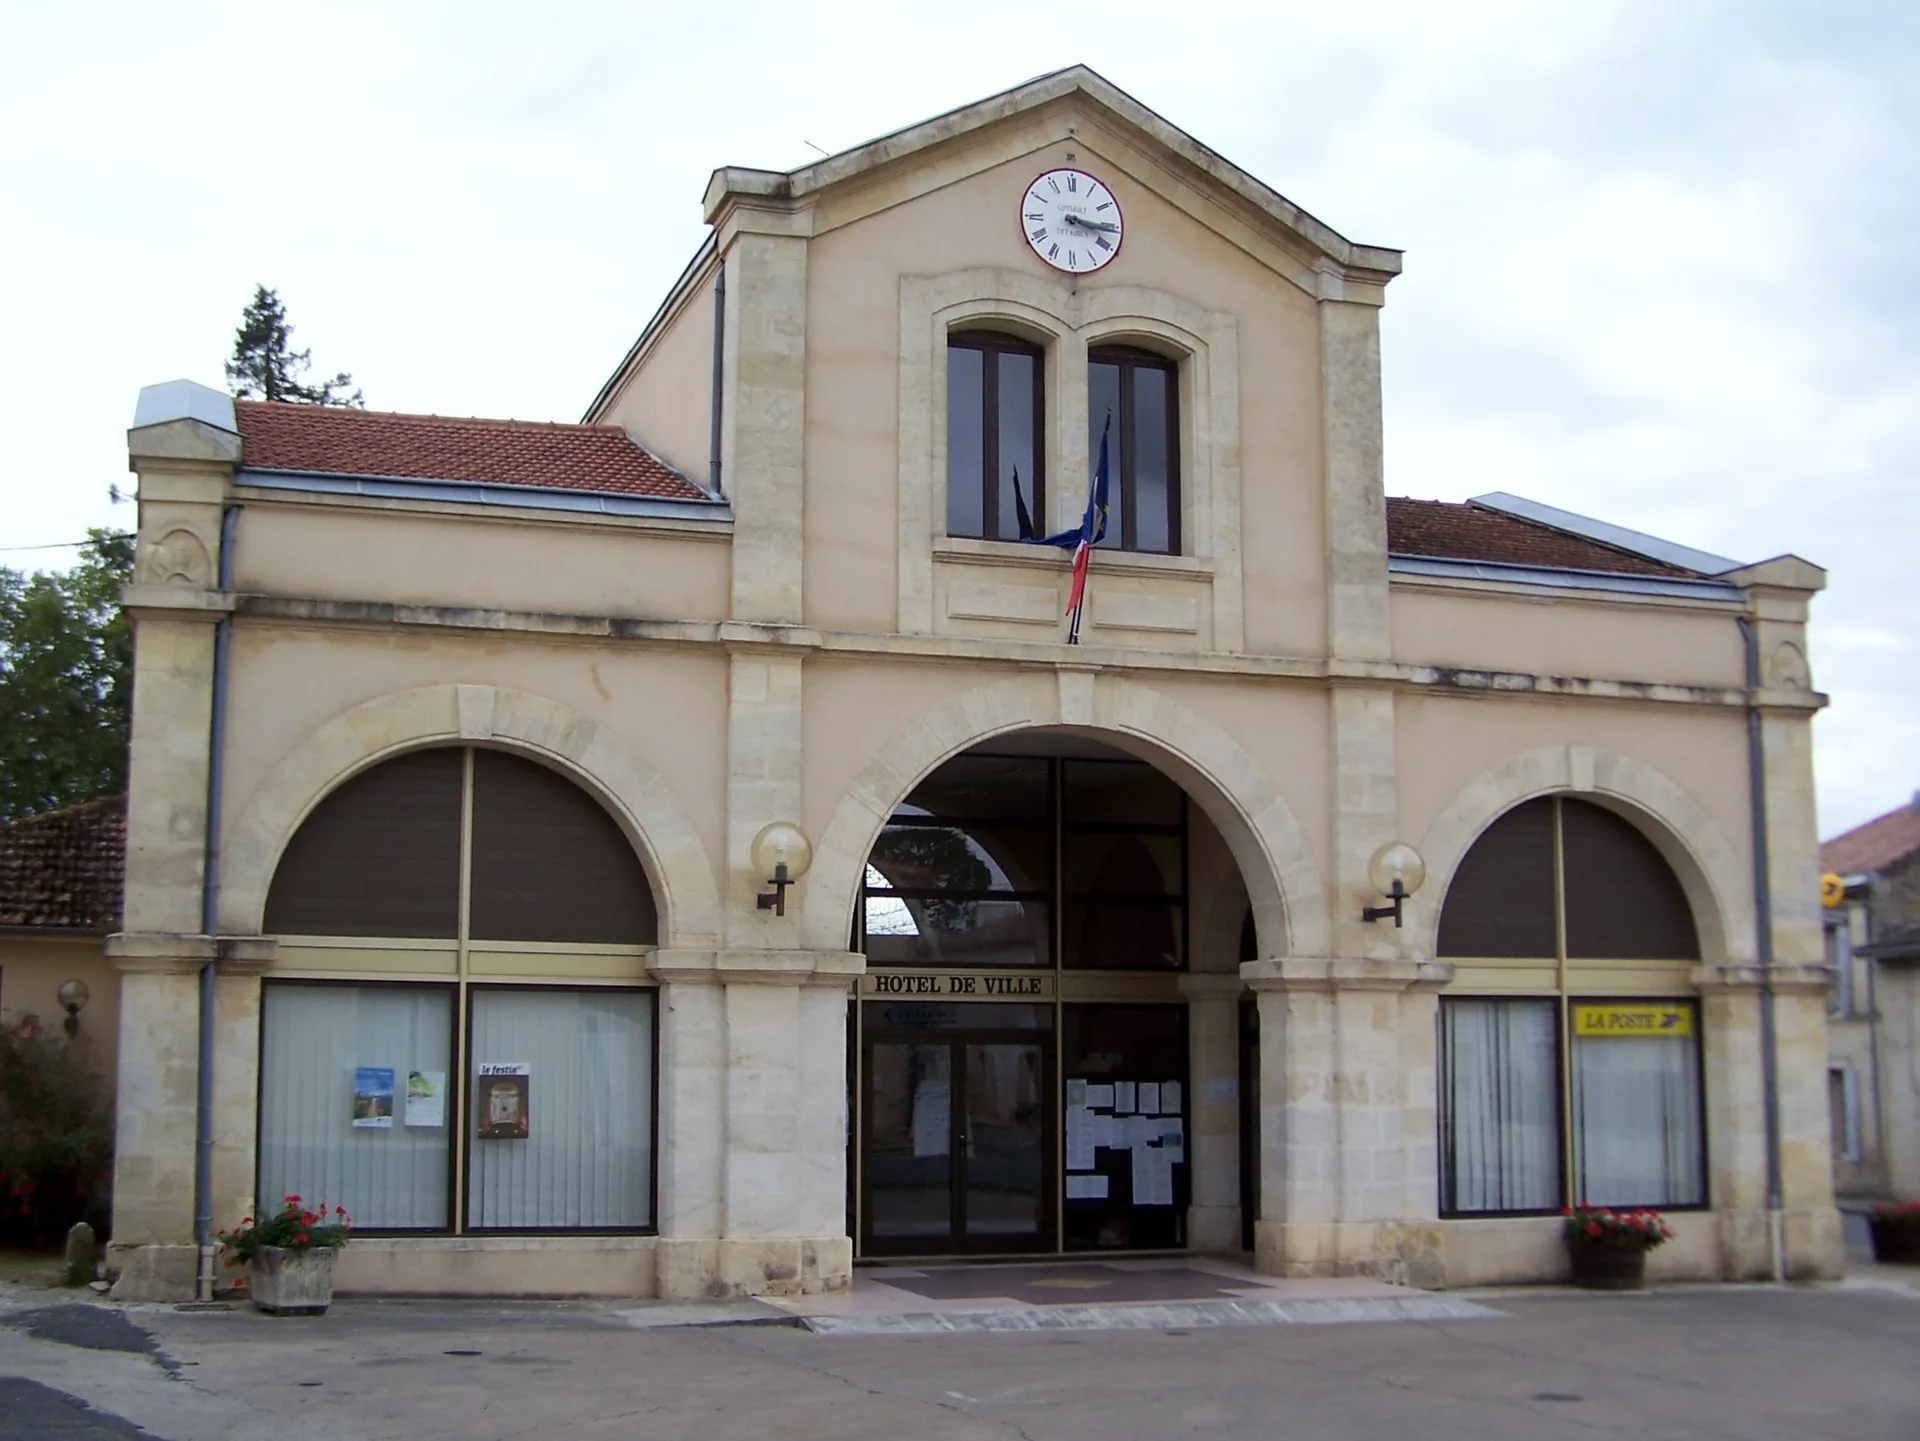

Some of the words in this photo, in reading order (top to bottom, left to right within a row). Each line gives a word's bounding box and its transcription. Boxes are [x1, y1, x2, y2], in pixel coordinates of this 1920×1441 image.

[875, 975, 941, 993] HOTEL
[949, 976, 976, 993] DE
[984, 977, 1042, 994] VILLE
[1586, 1013, 1605, 1029] LA
[1610, 1013, 1656, 1029] POSTE
[482, 1065, 491, 1074] le
[491, 1065, 517, 1075] festin
